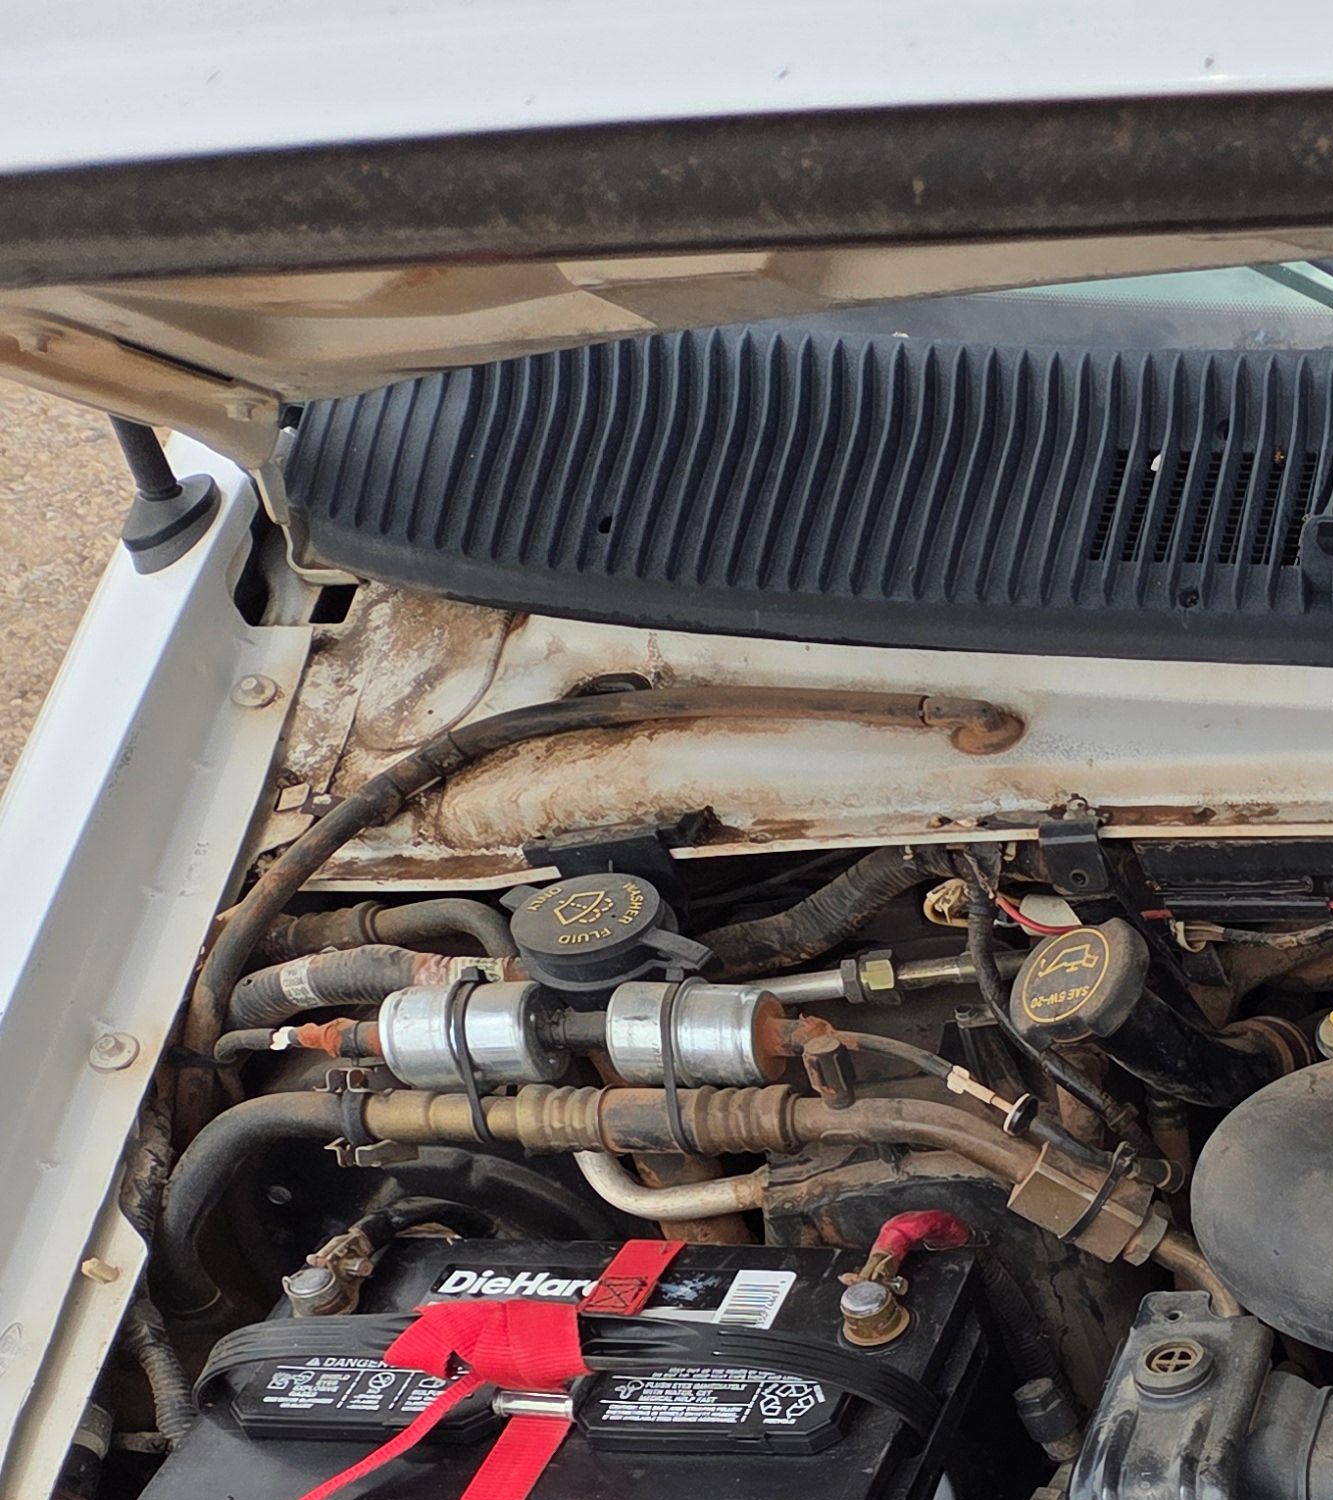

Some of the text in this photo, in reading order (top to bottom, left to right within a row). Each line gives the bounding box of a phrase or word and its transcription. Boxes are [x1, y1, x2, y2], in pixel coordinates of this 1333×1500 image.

[527, 882, 645, 945] WASHER FLUID ONLY
[1030, 985, 1091, 1009] SAE 5W-20
